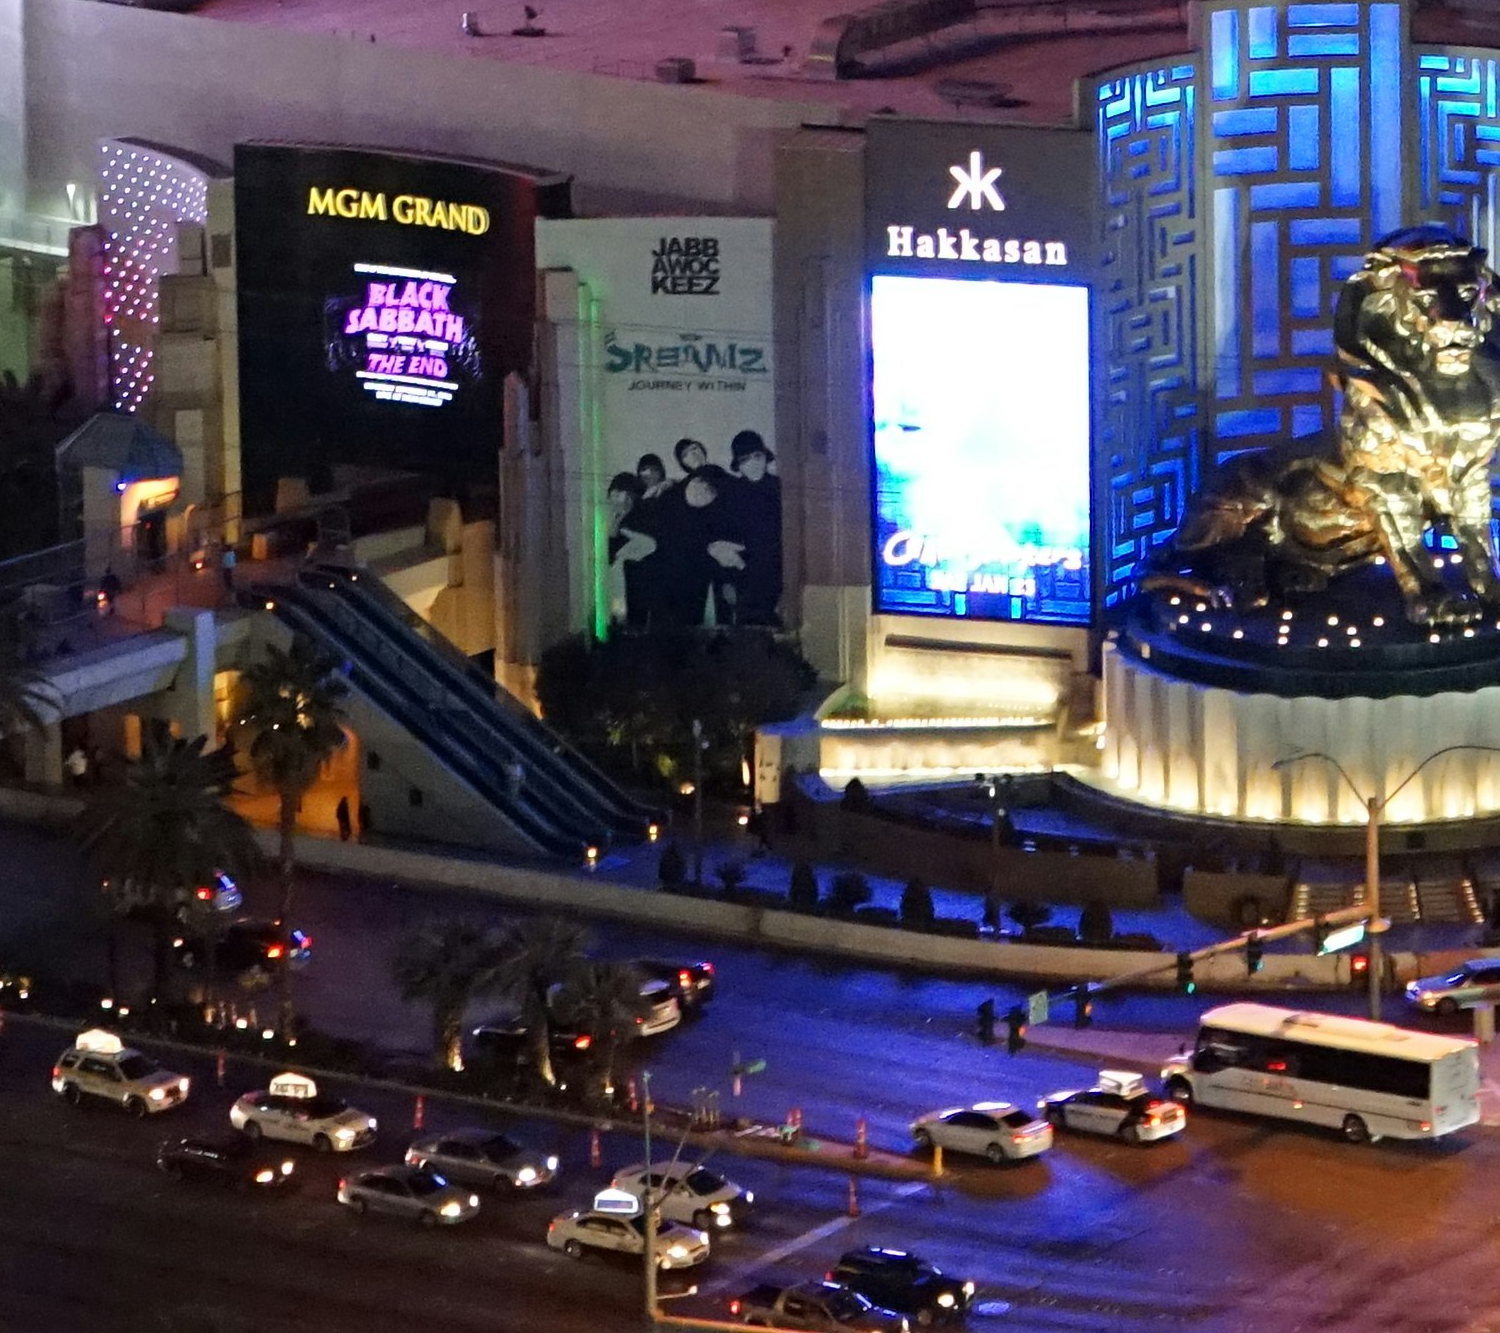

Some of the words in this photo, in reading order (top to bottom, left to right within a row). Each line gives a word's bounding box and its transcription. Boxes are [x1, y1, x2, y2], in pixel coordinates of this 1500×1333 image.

[307, 186, 388, 221] MGM
[392, 194, 490, 235] GRAND
[651, 236, 720, 258] JABB
[887, 225, 1068, 266] Hakkasan
[651, 257, 720, 275] AWOC
[368, 280, 451, 311] BLACK
[651, 275, 721, 296] KEEZ
[344, 306, 465, 344] SABBATH
[368, 352, 407, 374] THE
[408, 355, 449, 378] END
[628, 379, 692, 393] JOURNEY
[697, 379, 747, 392] WITHIN
